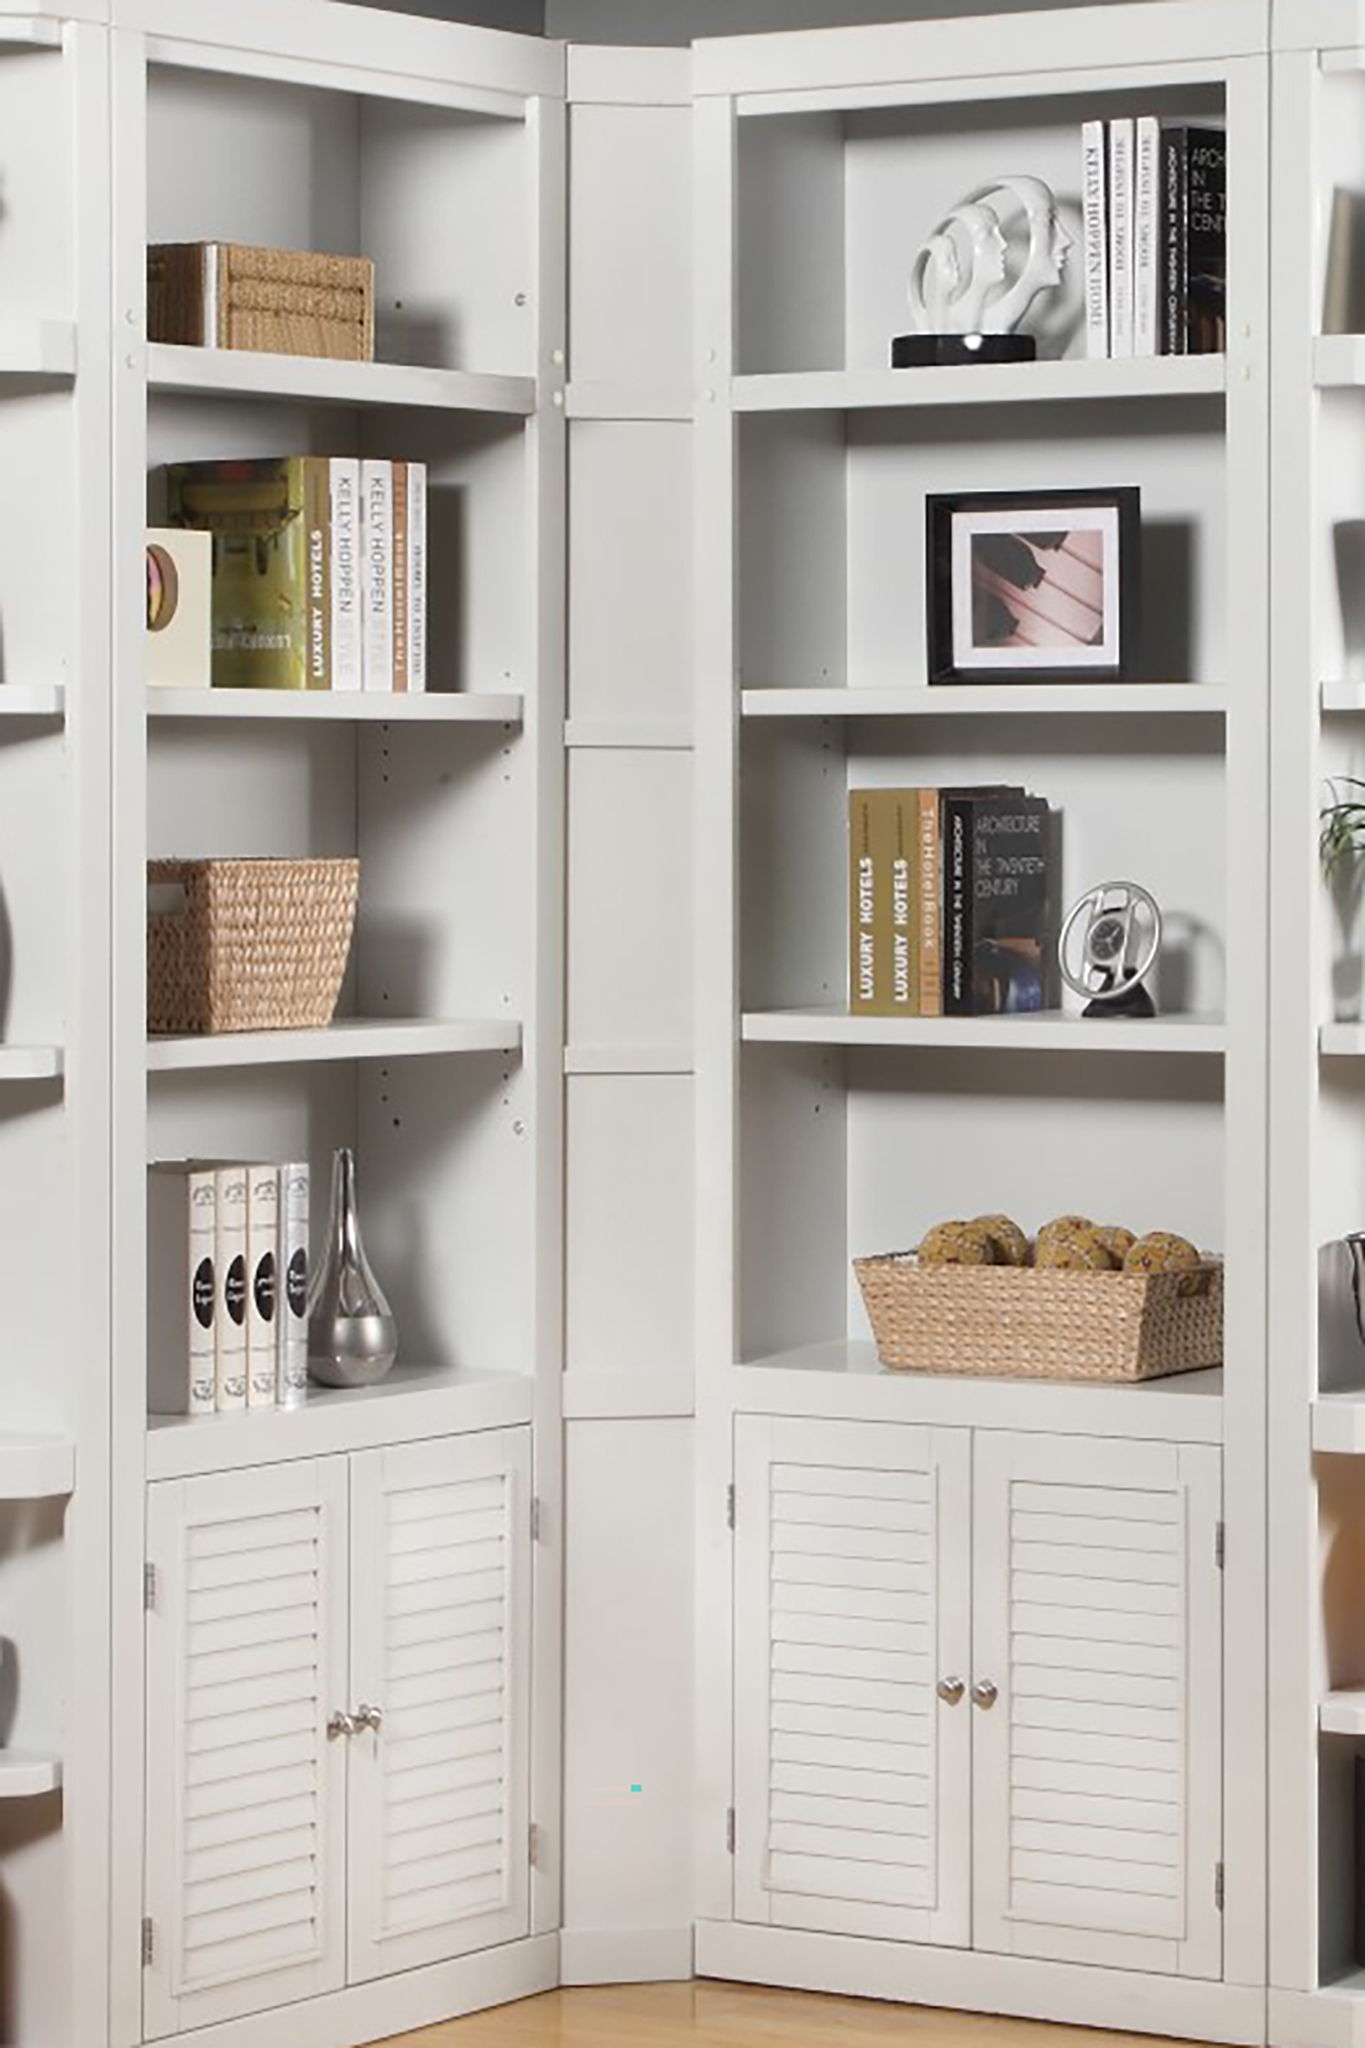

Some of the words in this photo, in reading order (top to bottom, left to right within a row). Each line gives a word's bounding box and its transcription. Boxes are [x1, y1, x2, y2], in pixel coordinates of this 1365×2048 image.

[339, 477, 351, 533] KELLY
[370, 477, 384, 532] KELLY
[311, 530, 323, 598] HOTELS
[339, 538, 352, 613] HOPPEN
[370, 538, 385, 613] HOPPEN
[311, 607, 323, 677] LUXURY
[860, 857, 874, 923] HOTELS
[894, 859, 908, 925] HOTELS
[860, 932, 874, 1000] LUXURY
[894, 934, 908, 1002] LUXURY
